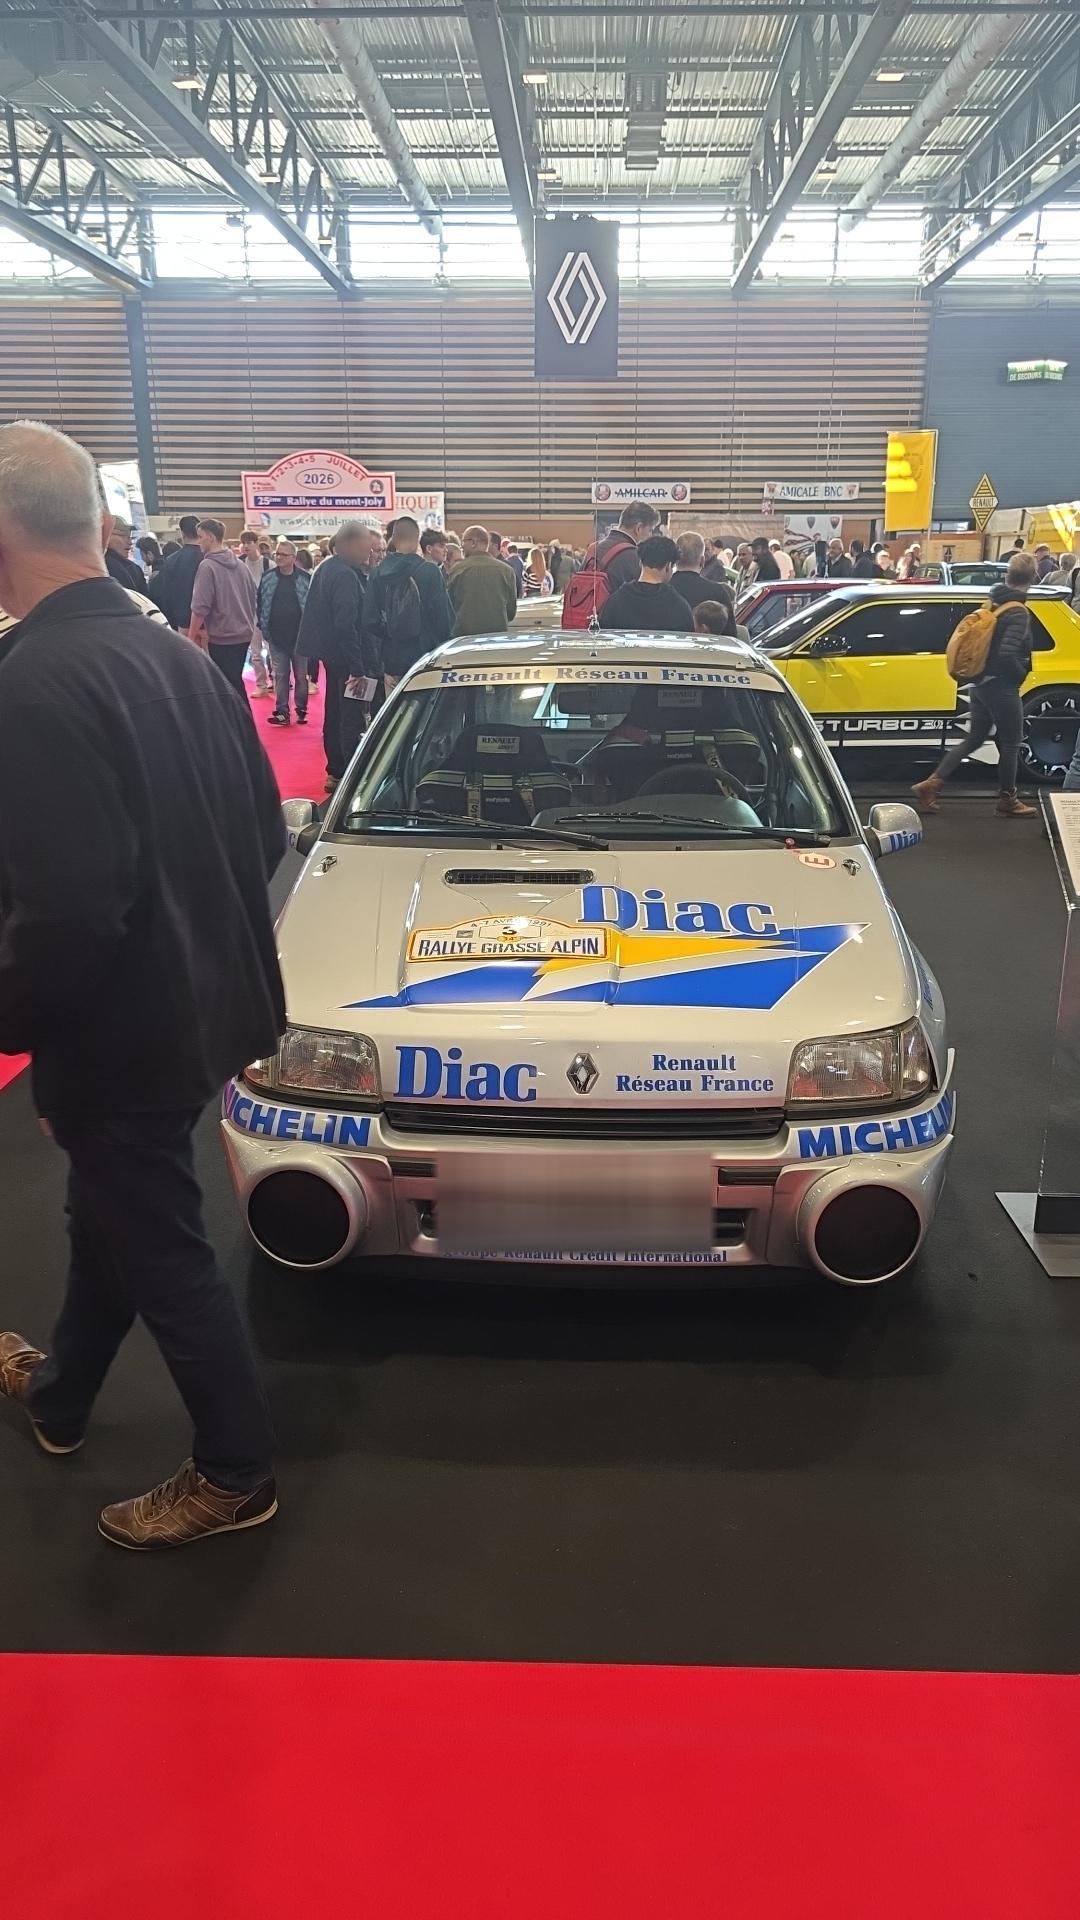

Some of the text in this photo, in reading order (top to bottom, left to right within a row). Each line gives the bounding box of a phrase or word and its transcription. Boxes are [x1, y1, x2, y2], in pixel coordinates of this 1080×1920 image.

[1017, 371, 1042, 381] SECOURS
[326, 456, 366, 482] JUILLET
[303, 473, 335, 485] 2026
[616, 488, 666, 498] AMILCAR
[780, 486, 843, 497] AMICALE BNC
[287, 496, 317, 507] Rallye
[320, 496, 333, 506] du
[334, 497, 384, 508] mont-Joly
[973, 497, 995, 508] RENAULT
[440, 667, 751, 685] Renault Réseau France
[577, 884, 779, 935] Diac
[501, 926, 518, 936] 3
[418, 938, 599, 956] RALLYE GRASSE ALPIN
[652, 1054, 737, 1071] Renault
[393, 1045, 537, 1102] Diac
[615, 1074, 774, 1092] Réseau France
